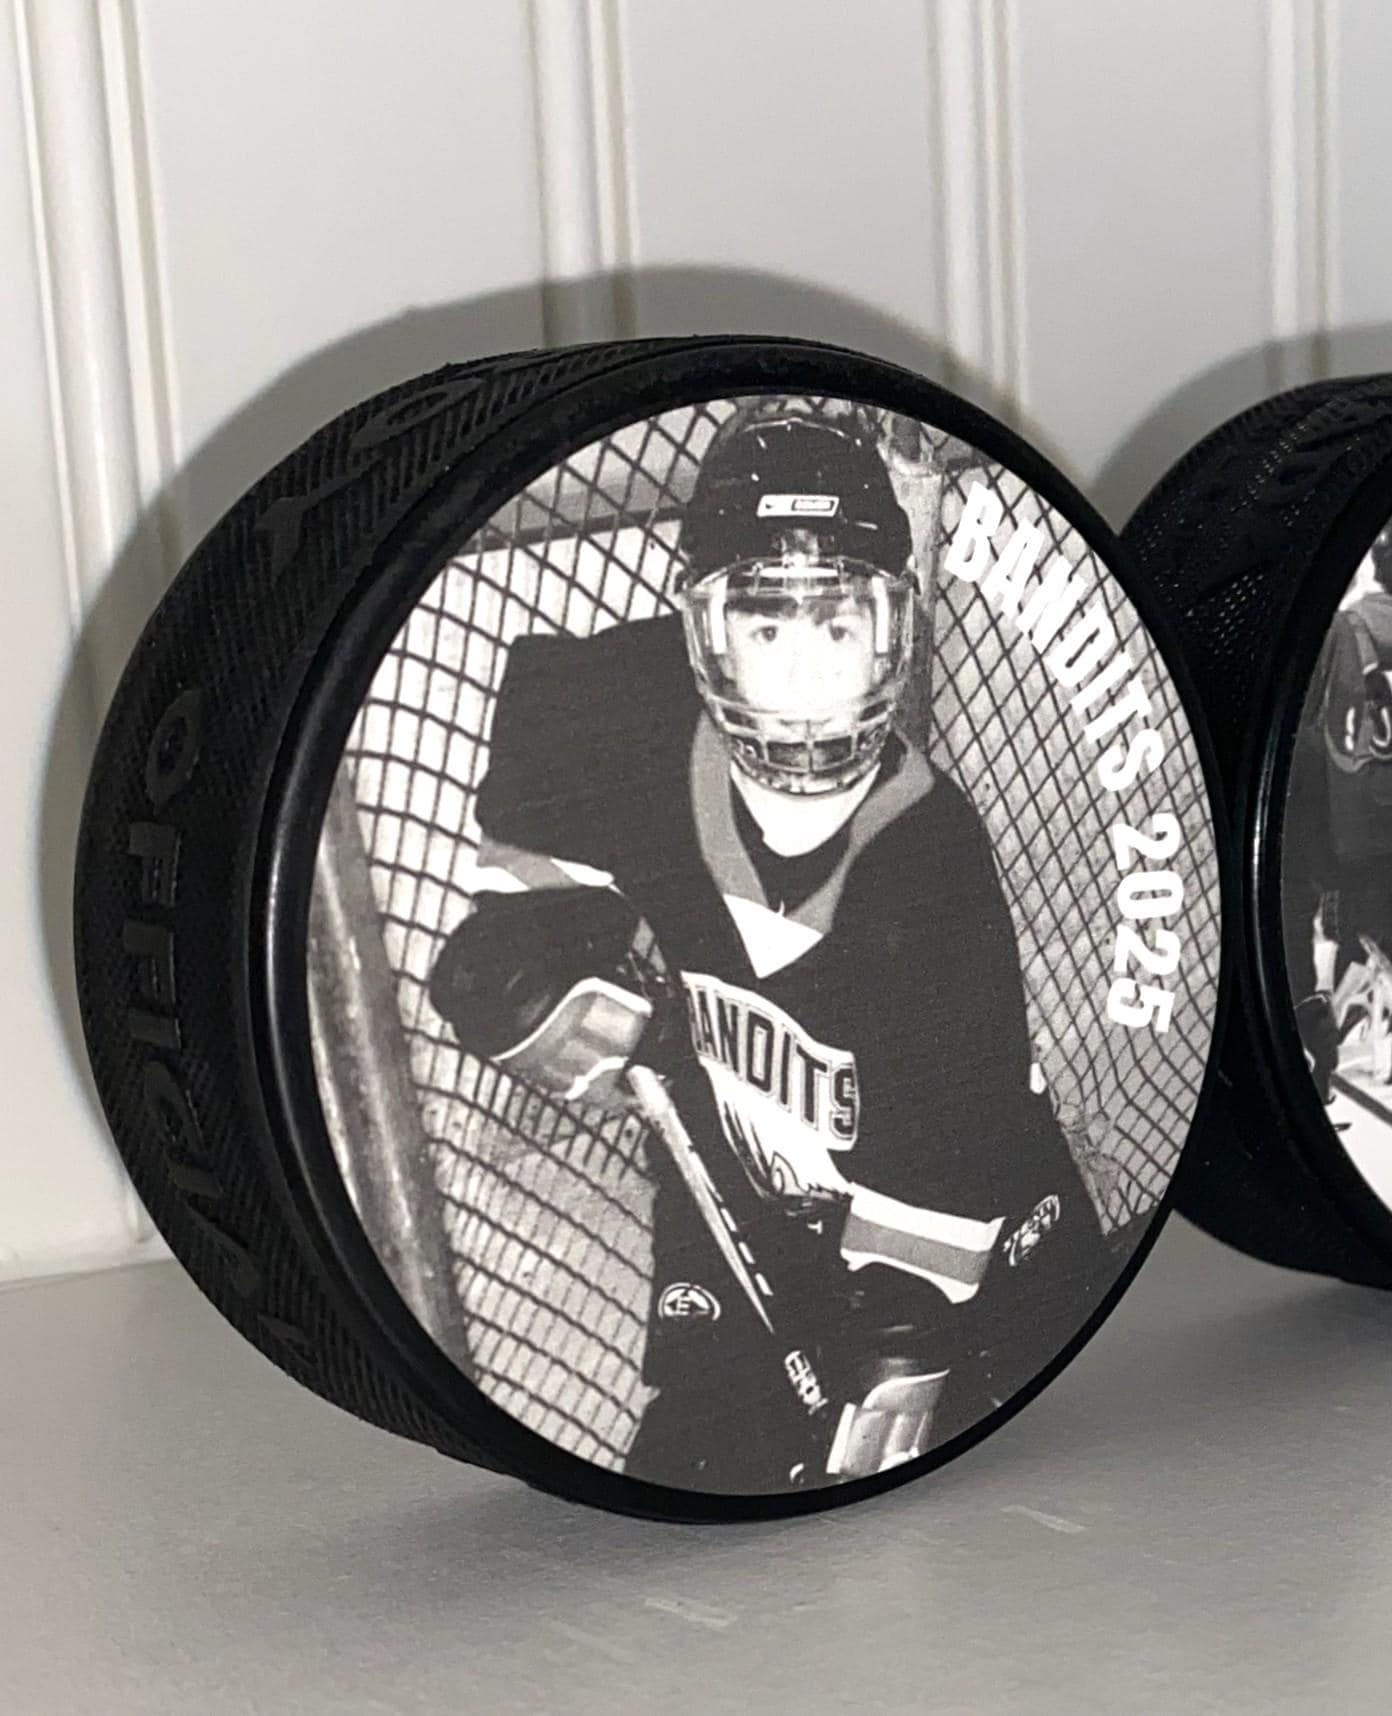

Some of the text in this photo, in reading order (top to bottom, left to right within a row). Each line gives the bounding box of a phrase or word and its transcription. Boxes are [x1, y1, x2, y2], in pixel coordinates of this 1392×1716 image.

[943, 480, 1185, 1034] BANDITS 2025
[688, 984, 858, 1141] ANDITS
